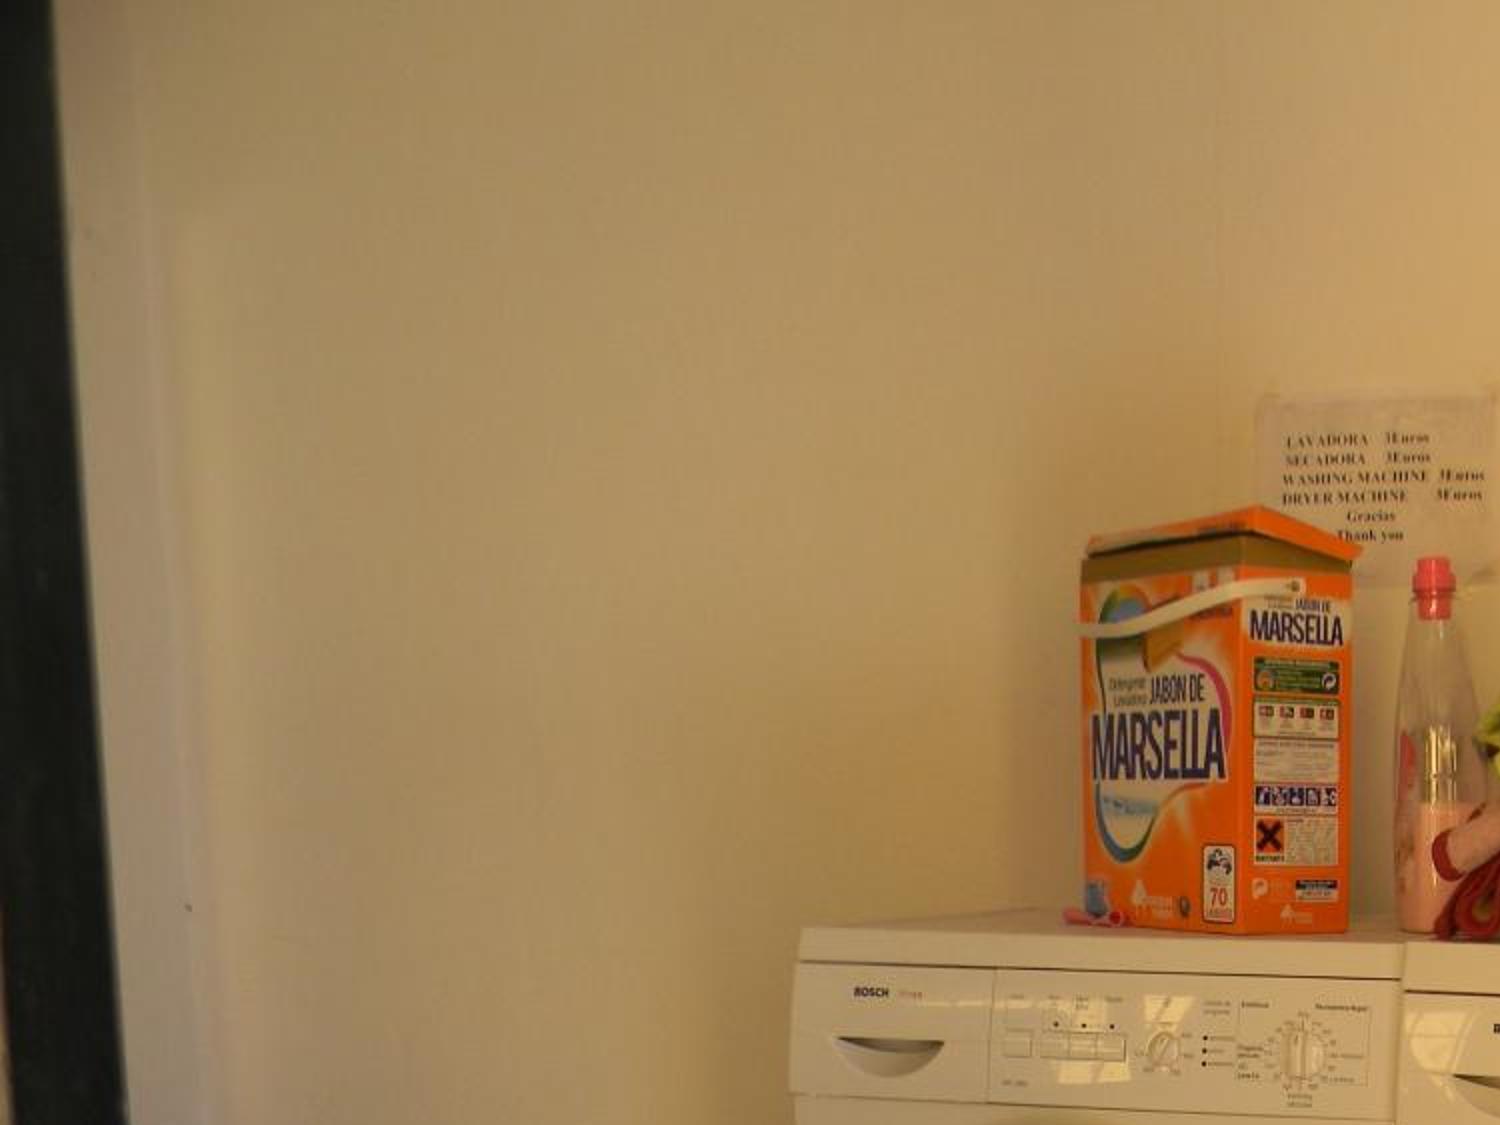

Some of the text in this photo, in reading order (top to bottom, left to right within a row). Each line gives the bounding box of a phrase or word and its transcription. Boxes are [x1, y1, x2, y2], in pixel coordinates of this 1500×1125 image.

[1286, 433, 1368, 449] LAVADORA
[1285, 451, 1366, 466] SECADORA
[1282, 471, 1353, 486] WASHING
[1357, 469, 1428, 485] MACHINE
[1282, 491, 1334, 507] DRYER
[1337, 488, 1407, 505] MACHINE
[1346, 510, 1396, 523] Gracias
[1381, 530, 1404, 545] you
[1249, 608, 1344, 647] MARSELLA
[1189, 673, 1205, 702] DE
[1091, 706, 1227, 781] MARSELLA
[1209, 886, 1229, 907] 70
[853, 986, 890, 999] BOSCH
